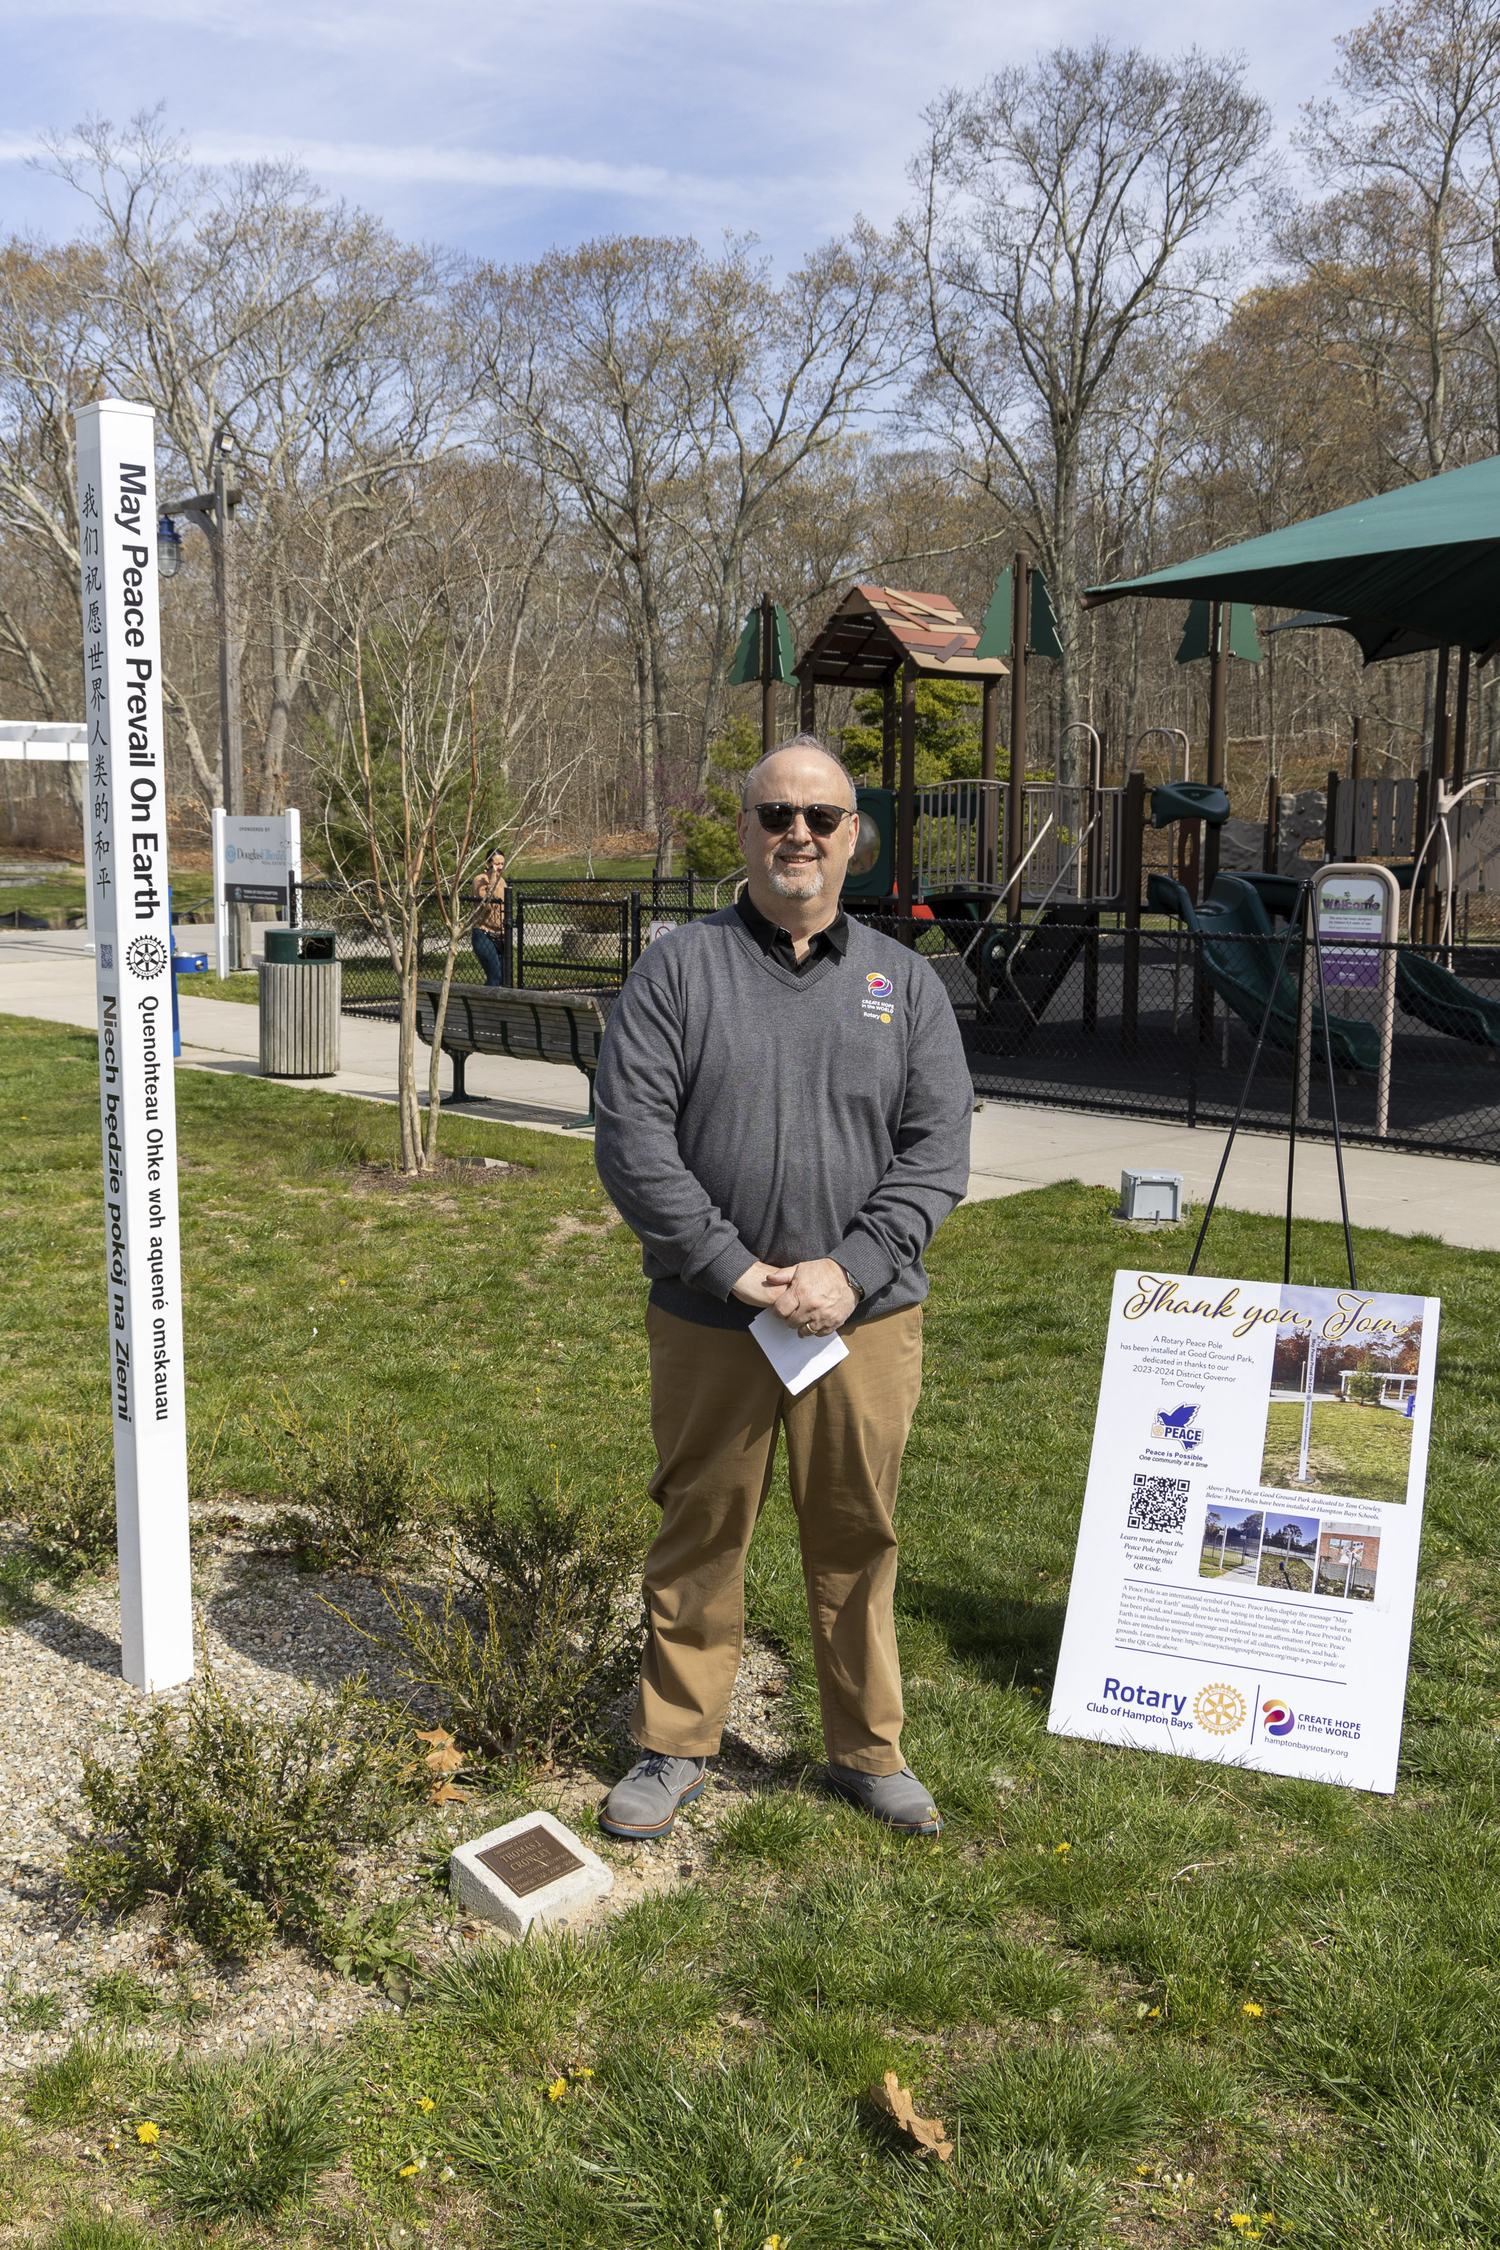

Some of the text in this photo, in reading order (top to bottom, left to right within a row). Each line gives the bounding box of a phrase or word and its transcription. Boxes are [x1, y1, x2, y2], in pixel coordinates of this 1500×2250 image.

[114, 462, 147, 536] May
[122, 544, 149, 648] Peace
[82, 482, 113, 899] 我们祝愿世界人类的和平
[125, 658, 156, 767] Prevail
[130, 777, 157, 822] On
[132, 833, 161, 920] Earth
[1323, 899, 1380, 910] Welcome
[138, 995, 161, 1121] Quenohteau
[146, 1128, 164, 1181] Ohke
[102, 995, 132, 1423] Niech będzie pokój na Ziemi
[148, 1188, 166, 1229] woh
[147, 1236, 169, 1310] aquené
[1123, 1275, 1408, 1340] Thank you, Tom
[1119, 1342, 1131, 1350] has
[1132, 1343, 1149, 1351] been
[1150, 1345, 1178, 1355] installed
[1187, 1348, 1207, 1358] Good
[1208, 1350, 1235, 1361] Ground
[1236, 1353, 1254, 1364] Park,
[1160, 1335, 1184, 1347] Rotary
[1185, 1338, 1206, 1347] Peace
[1207, 1340, 1222, 1349] Pole
[152, 1317, 171, 1421] omskauau
[1141, 1355, 1175, 1365] dedicated
[1184, 1359, 1206, 1368] thanks
[1132, 1364, 1236, 1382] 2023-2024 District Governor
[1160, 1377, 1205, 1392] Tom Crowley
[1164, 1427, 1202, 1441] PEACE
[1145, 1448, 1165, 1456] Peace
[1174, 1451, 1203, 1461] Possible
[1151, 1456, 1182, 1466] community
[1310, 1498, 1337, 1506] dedicated
[1358, 1504, 1381, 1513] Crowley.
[1316, 1506, 1342, 1515] Hampton
[1358, 1511, 1379, 1520] Schools.
[1119, 1532, 1138, 1541] Learn
[1123, 1542, 1141, 1550] Peace
[1155, 1547, 1177, 1556] Project
[1125, 1551, 1133, 1560] by
[1133, 1554, 1161, 1564] scanning
[1144, 1564, 1161, 1572] Code.
[1136, 1595, 1155, 1603] Prevail
[1264, 1614, 1289, 1624] language
[1306, 1622, 1328, 1630] country
[1168, 1592, 1202, 1601] international
[1278, 1608, 1297, 1617] display
[1308, 1613, 1331, 1622] message
[1332, 1615, 1347, 1624] "May
[1103, 1678, 1187, 1716] Rotary
[1086, 1702, 1193, 1730] Club of Hampton Bays
[1298, 1713, 1361, 1731] CREATE HOPE
[1297, 1722, 1360, 1739] in the WORLD
[1264, 1736, 1349, 1758] hamptonbaysrotary.org
[500, 1843, 536, 1863] THOMAS
[510, 1847, 551, 1871] CROWLEY
